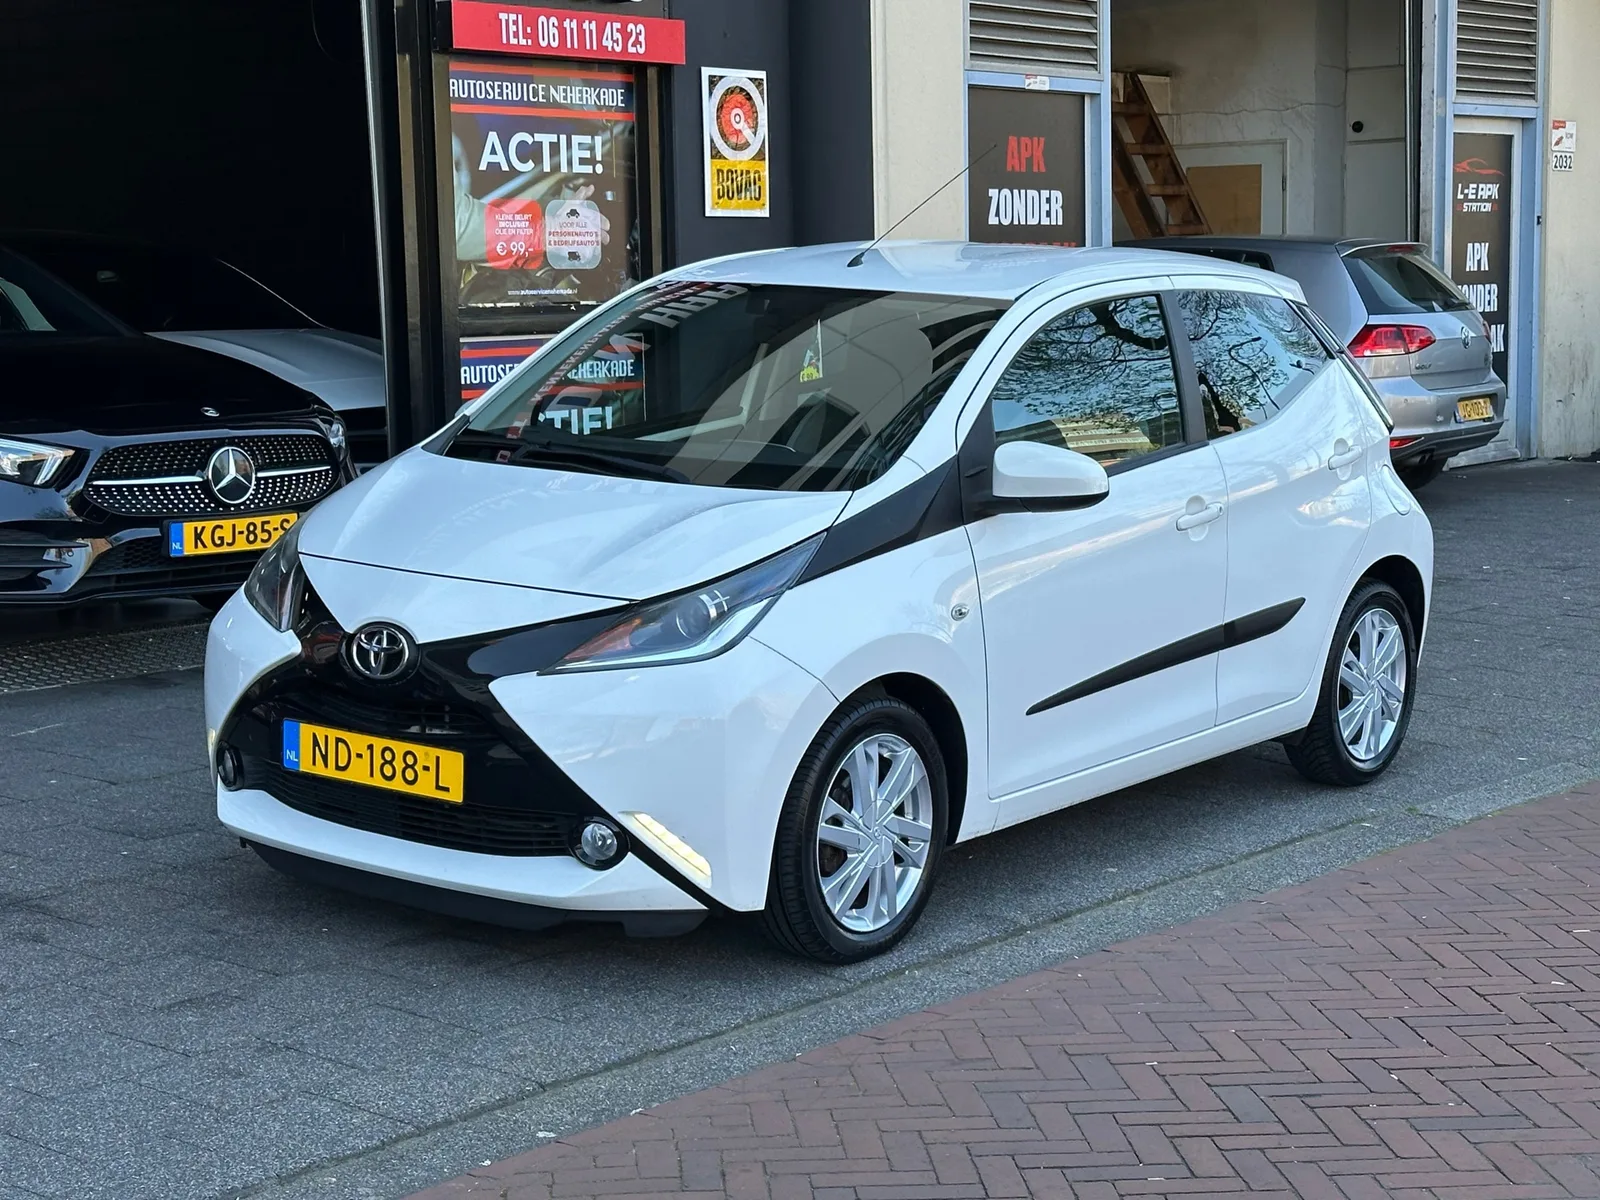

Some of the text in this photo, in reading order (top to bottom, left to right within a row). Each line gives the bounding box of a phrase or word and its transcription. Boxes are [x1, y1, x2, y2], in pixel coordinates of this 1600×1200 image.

[498, 12, 646, 54] TEL: 06 11 11 45 23
[449, 78, 626, 107] AUTOSERVICE NEHERKADE
[478, 131, 604, 175] ACTIE!
[1006, 135, 1046, 173] APK
[1553, 154, 1573, 170] 2032
[716, 168, 762, 202] BOVAG
[1457, 183, 1500, 199] L-E APK
[987, 188, 1063, 226] ZONDER
[1462, 202, 1492, 212] STATION
[496, 241, 508, 256] €
[1465, 242, 1489, 271] APK
[1457, 284, 1498, 312] NDER
[460, 359, 635, 385] AUTOSE EHERKADE
[538, 406, 613, 435] TIE!
[172, 542, 183, 550] NL
[286, 731, 451, 793] NL ND-188-L
